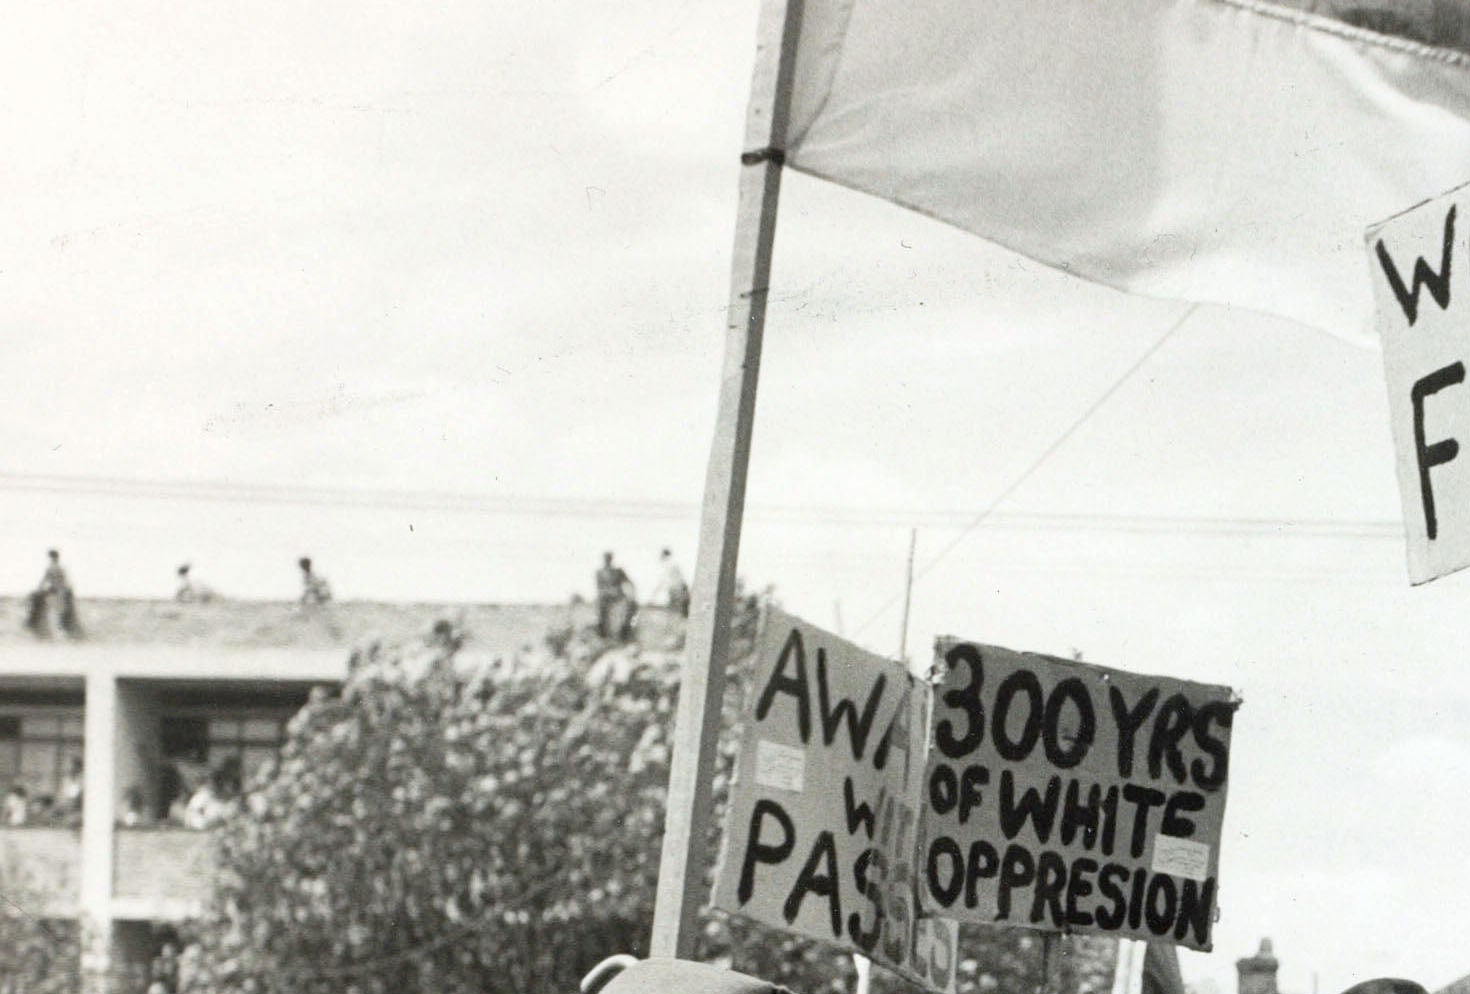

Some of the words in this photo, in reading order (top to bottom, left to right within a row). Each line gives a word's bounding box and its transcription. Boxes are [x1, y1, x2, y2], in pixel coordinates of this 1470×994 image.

[929, 764, 990, 824] OF
[1000, 769, 1205, 858] WHITE
[927, 835, 1215, 946] OPPRESION
